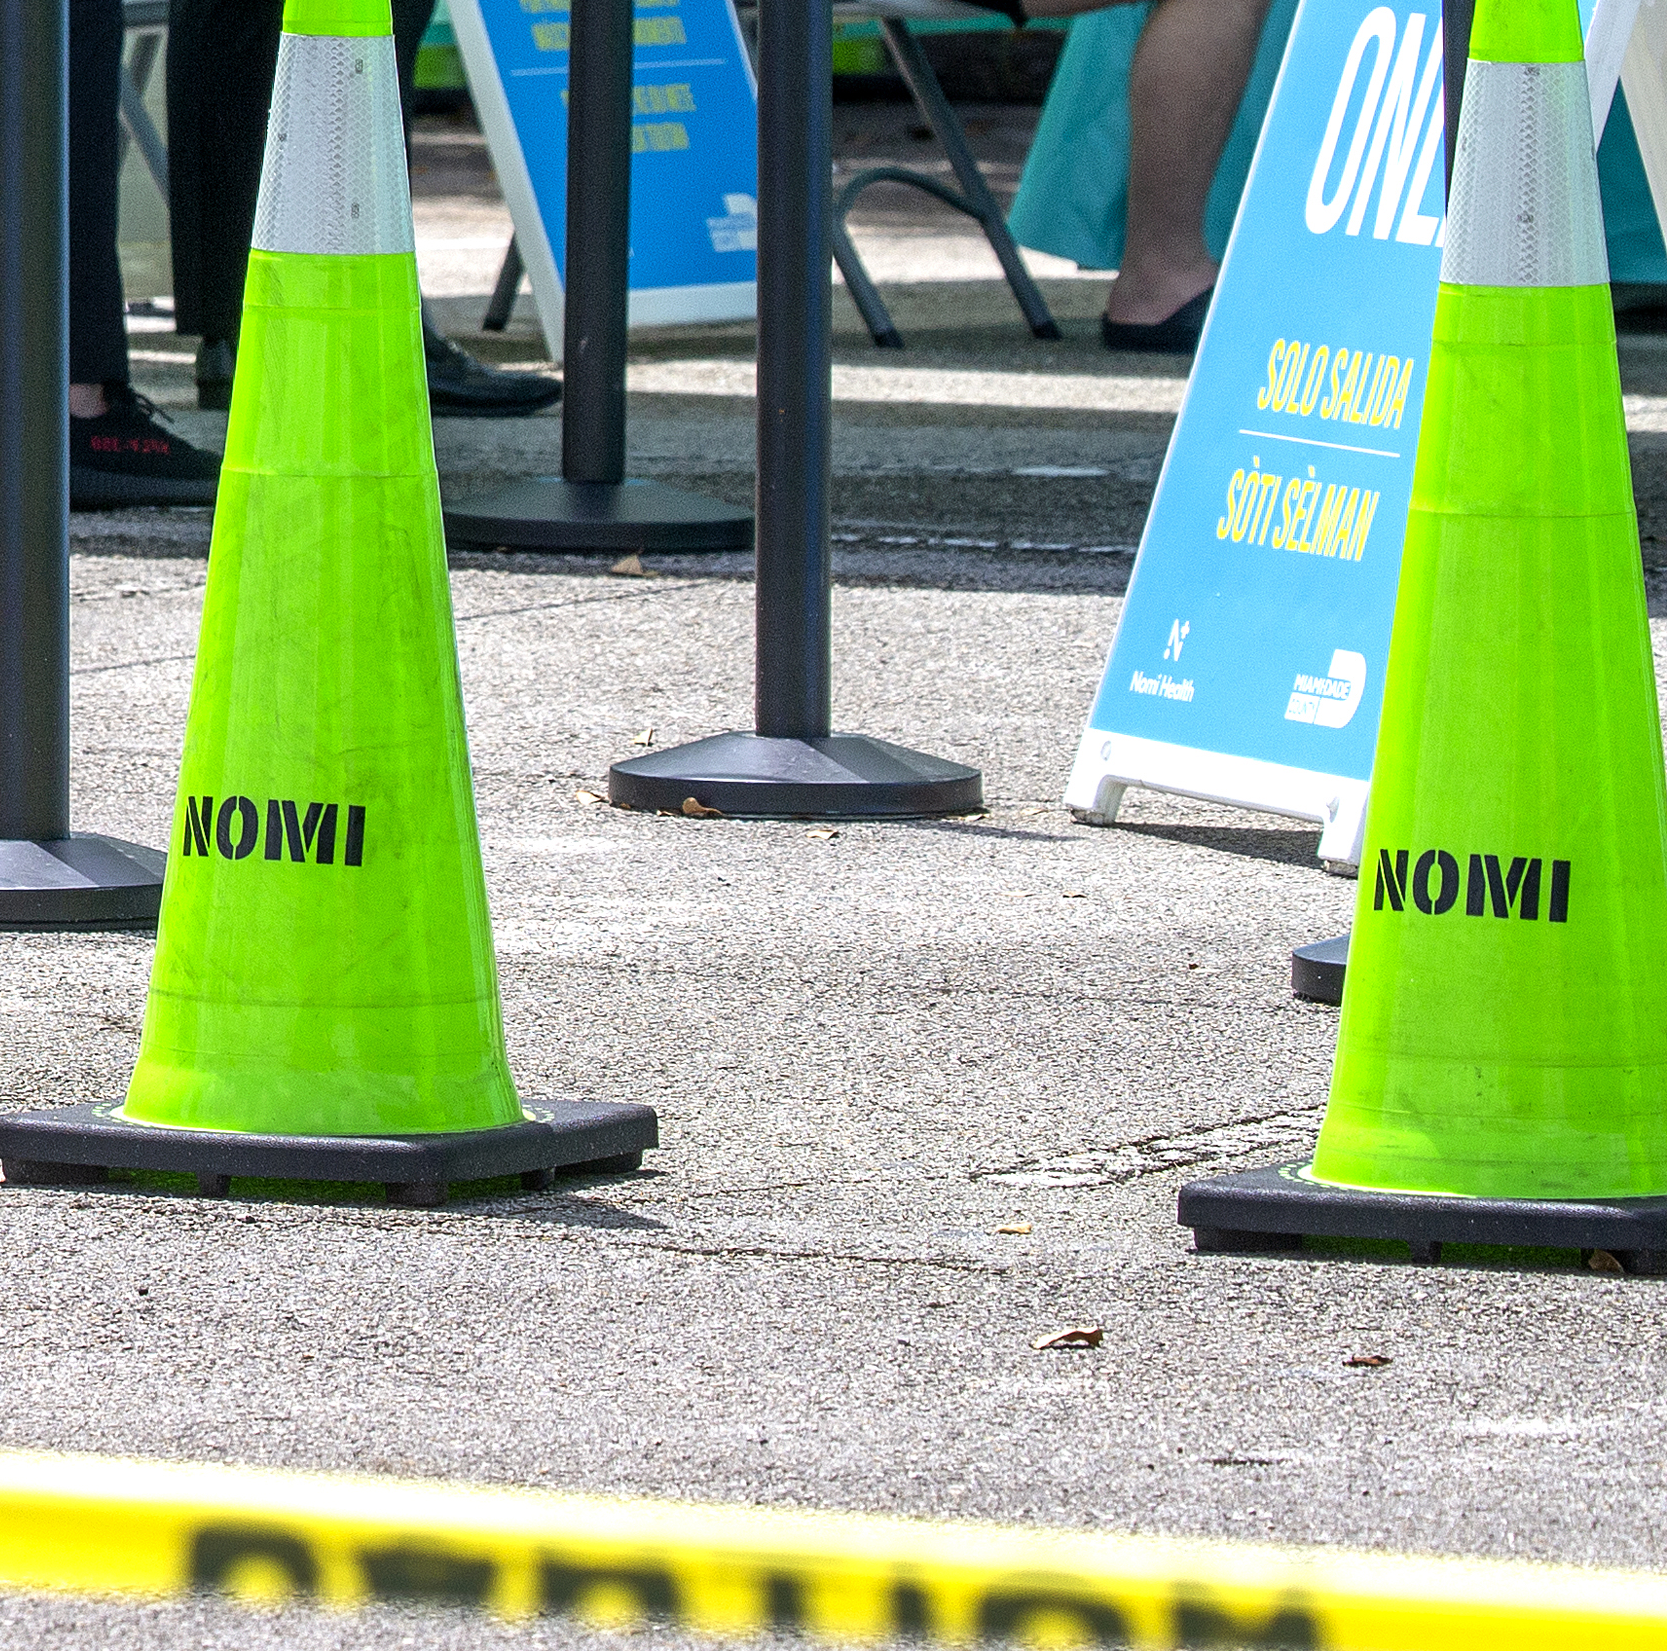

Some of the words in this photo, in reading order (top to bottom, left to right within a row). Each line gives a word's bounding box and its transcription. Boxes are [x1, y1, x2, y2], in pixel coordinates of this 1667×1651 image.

[1305, 6, 1445, 248] ONL
[1257, 338, 1330, 417] SOLO
[1320, 347, 1415, 430] SALIDA
[1130, 670, 1162, 696] Nomi
[183, 796, 366, 867] NOMI
[1374, 849, 1571, 924] NOMI
